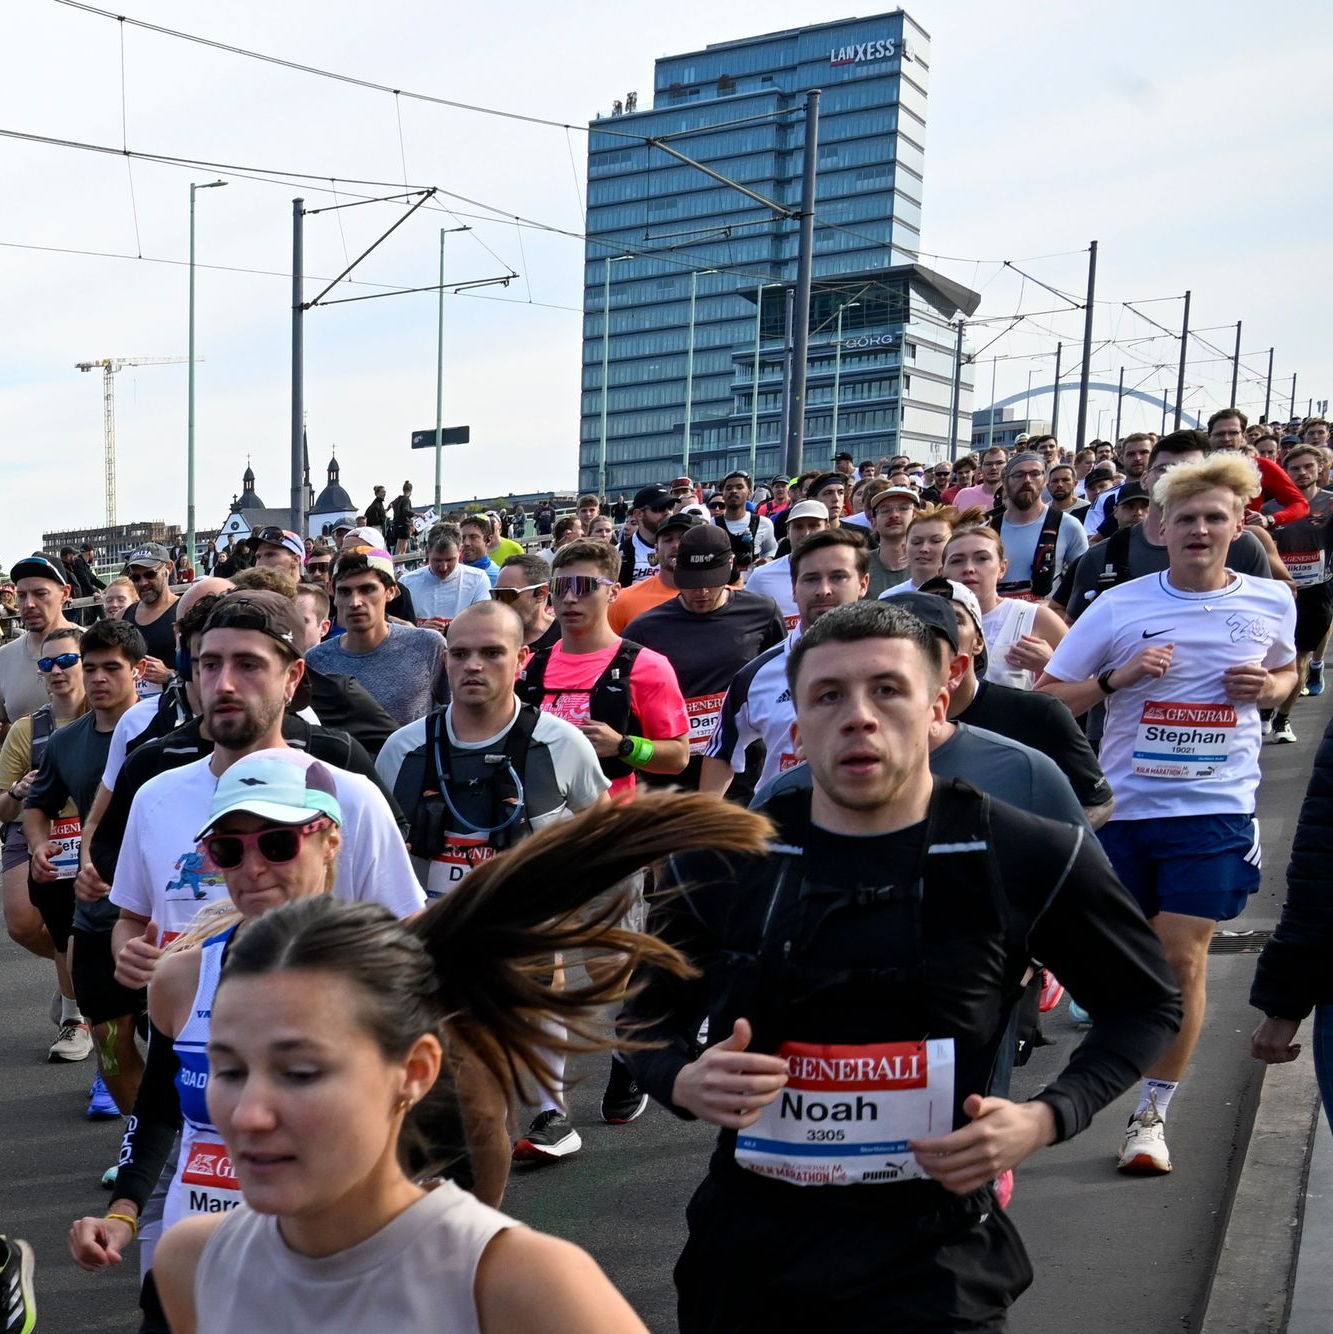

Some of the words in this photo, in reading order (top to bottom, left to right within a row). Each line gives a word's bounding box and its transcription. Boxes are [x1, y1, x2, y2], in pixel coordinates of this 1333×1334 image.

[830, 38, 894, 63] LANXESS
[135, 680, 148, 688] irk
[1145, 727, 1226, 746] Stephan
[788, 1054, 921, 1083] GENERALI
[781, 1092, 878, 1122] Noah
[806, 1129, 846, 1142] 3305
[775, 1165, 830, 1182] MARATHON
[862, 1169, 899, 1181] PUMA
